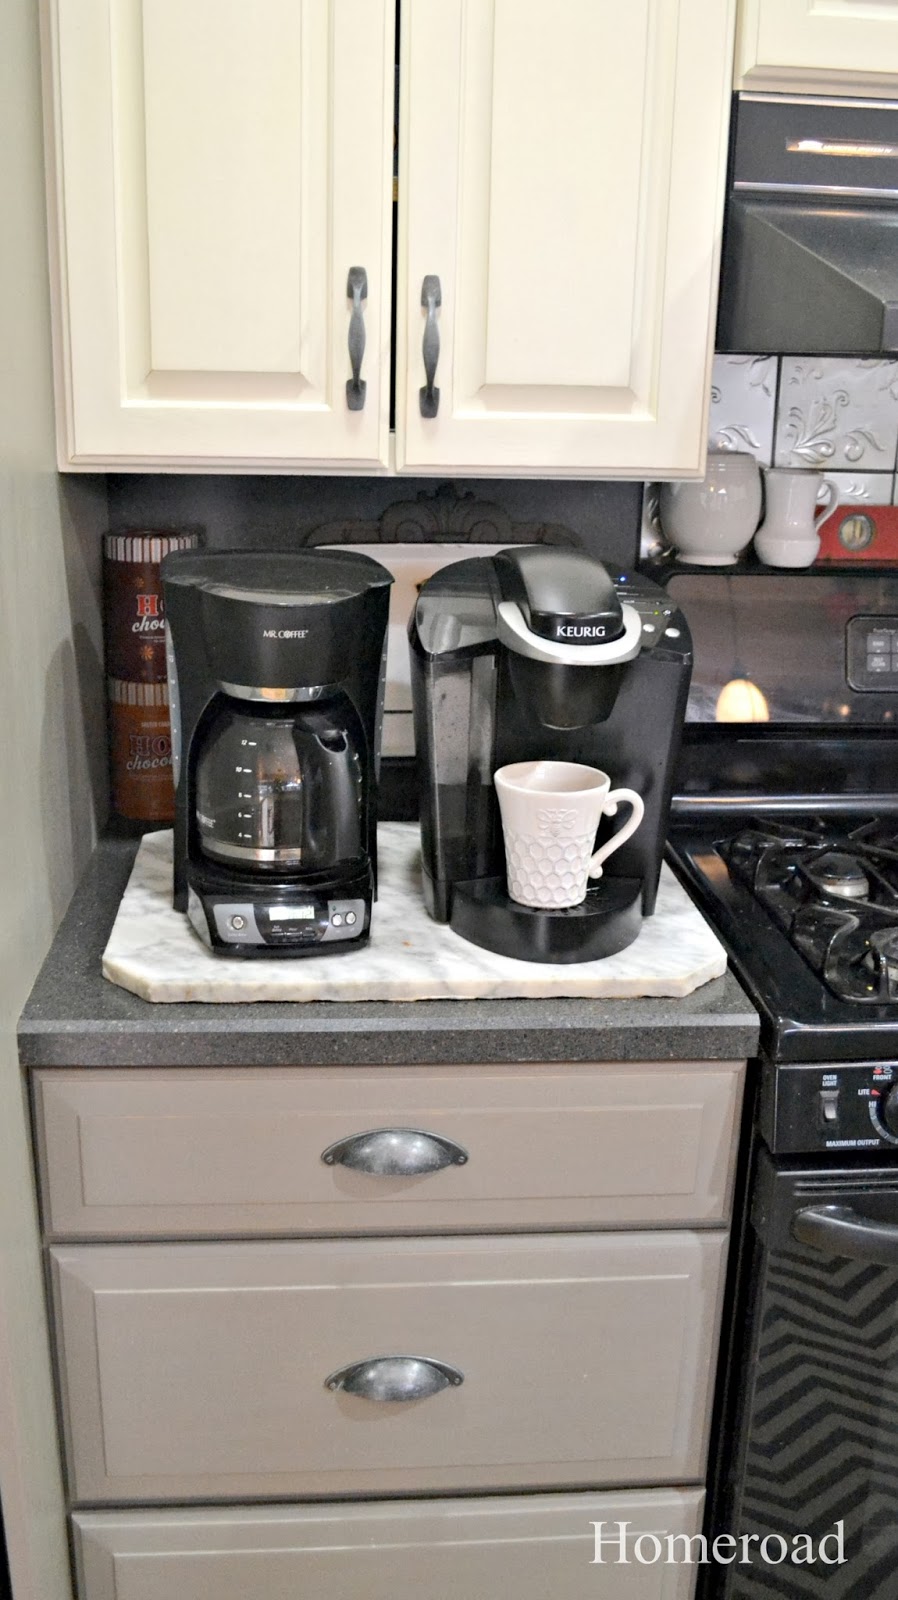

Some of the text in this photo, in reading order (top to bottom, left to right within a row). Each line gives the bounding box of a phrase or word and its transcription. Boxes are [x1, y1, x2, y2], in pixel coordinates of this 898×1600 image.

[556, 625, 606, 638] KEURIG
[129, 735, 171, 757] HO
[126, 755, 173, 770] choco
[857, 1088, 870, 1096] LITE
[826, 1138, 880, 1147] MAXIMUM OUTPUT
